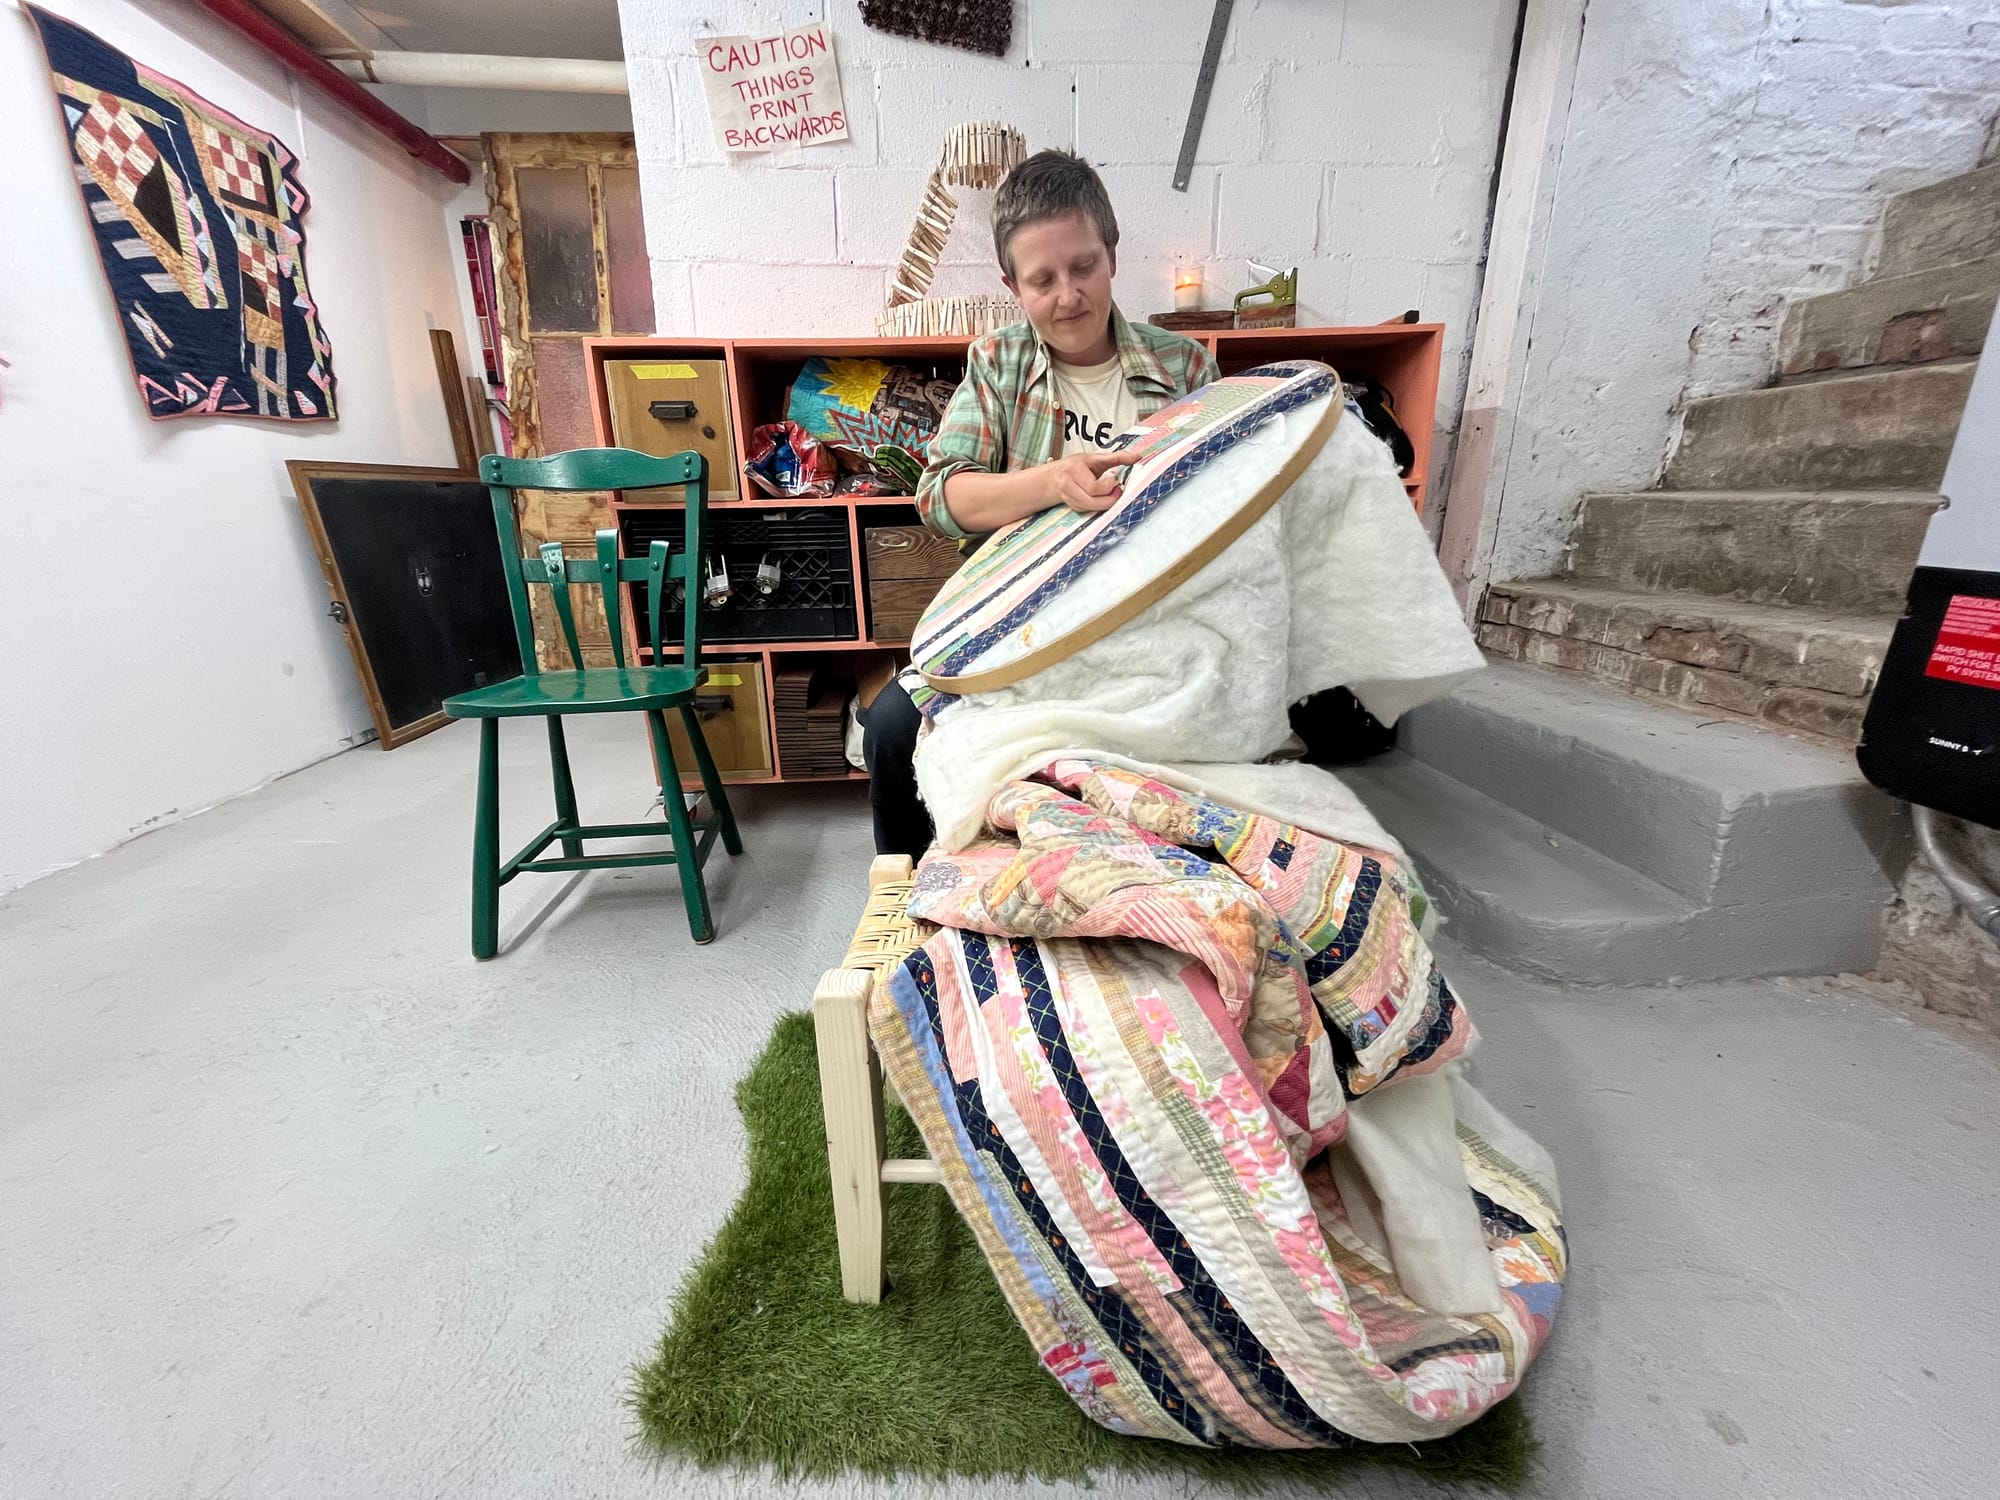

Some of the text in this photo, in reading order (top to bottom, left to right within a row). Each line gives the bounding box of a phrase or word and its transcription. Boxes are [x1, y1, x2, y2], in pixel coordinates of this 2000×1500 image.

[708, 29, 827, 72] CAUTION
[731, 66, 815, 102] THINGS
[749, 92, 814, 121] PRINT
[724, 111, 845, 148] BACKWARDS
[1931, 652, 1970, 667] SWITCH
[1969, 659, 1991, 670] FOR
[1936, 644, 1967, 656] RAPID
[1966, 649, 1997, 661] SHUT
[1945, 664, 1962, 675] PV
[1929, 737, 1962, 750] SUNNY
